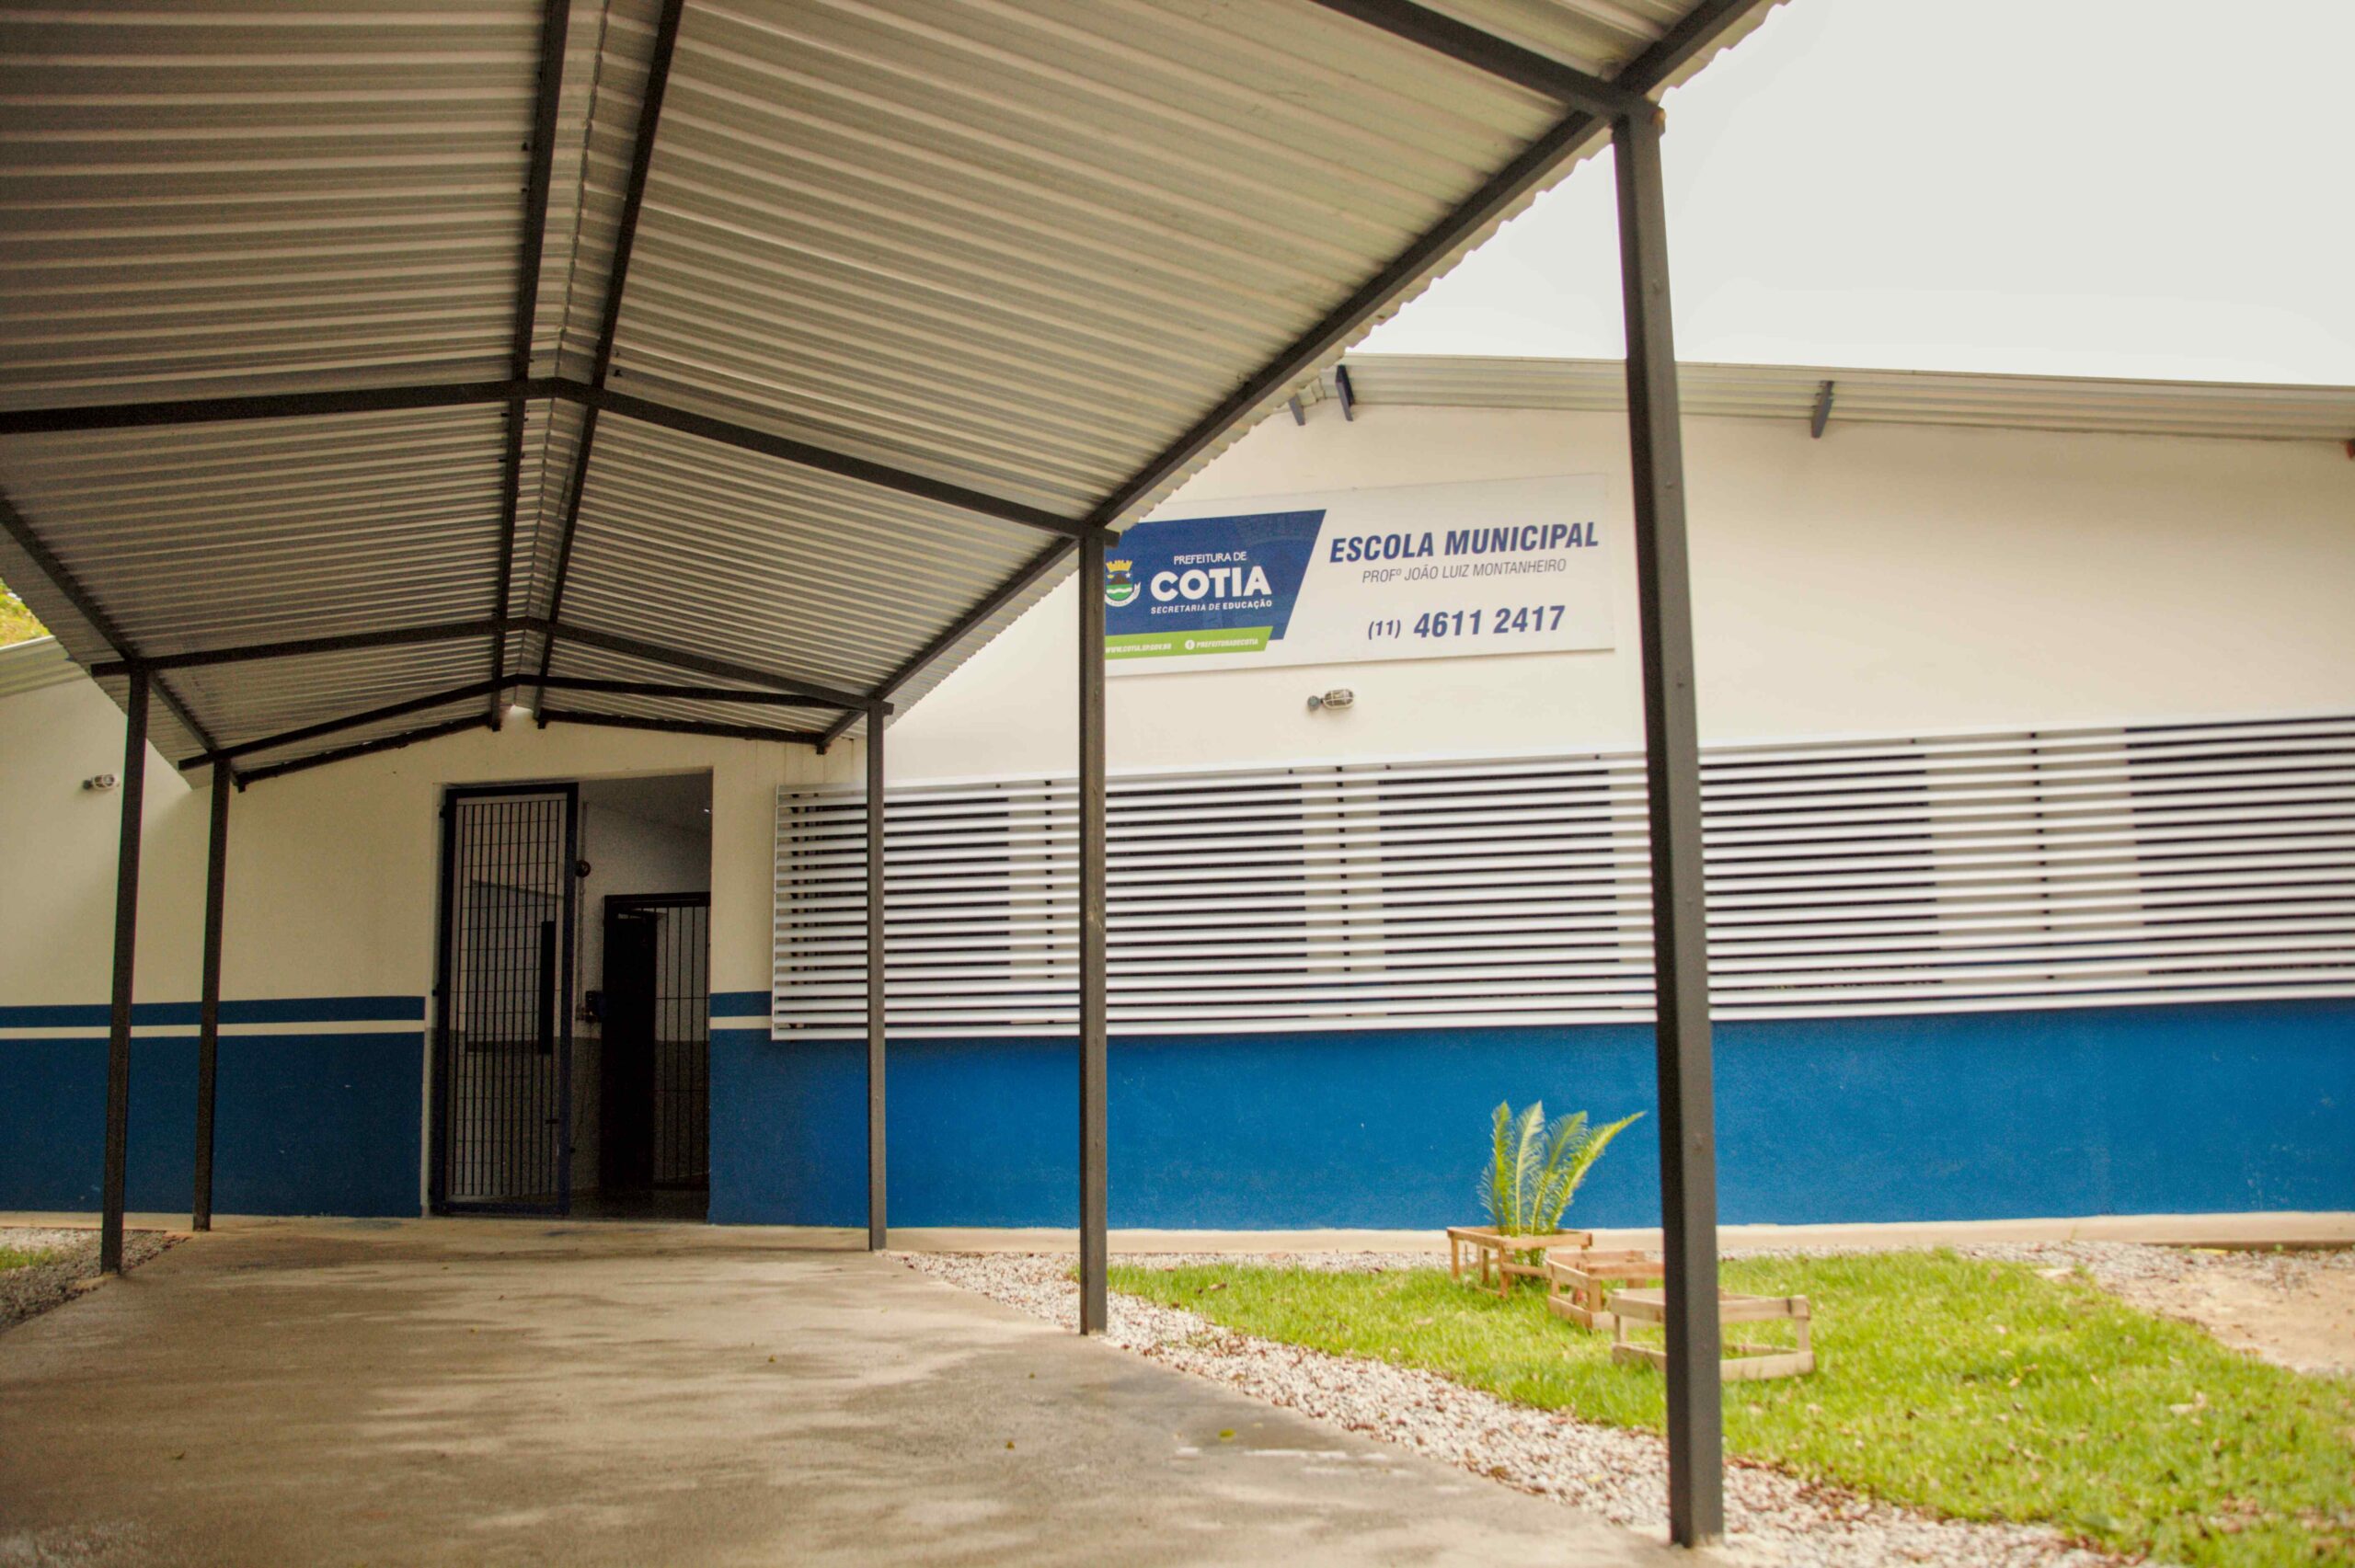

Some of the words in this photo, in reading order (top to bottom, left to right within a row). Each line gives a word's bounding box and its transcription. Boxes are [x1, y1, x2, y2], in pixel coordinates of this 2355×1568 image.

[1330, 532, 1434, 563] ESCOLA
[1444, 521, 1599, 555] MUNICIPAL
[1174, 554, 1232, 565] PREFEITURA
[1233, 552, 1246, 562] DE
[1404, 564, 1439, 581] JOÃO
[1442, 565, 1470, 578] LUIZ
[1472, 558, 1567, 577] MONTANHEIRO
[1150, 566, 1272, 601] COTIA
[1151, 603, 1206, 614] SECRETARIA
[1209, 602, 1221, 611] DE
[1223, 598, 1272, 611] EDUCAÇÃO
[1368, 619, 1401, 640] (11)
[1414, 610, 1482, 638] 4611
[1493, 605, 1566, 634] 2417
